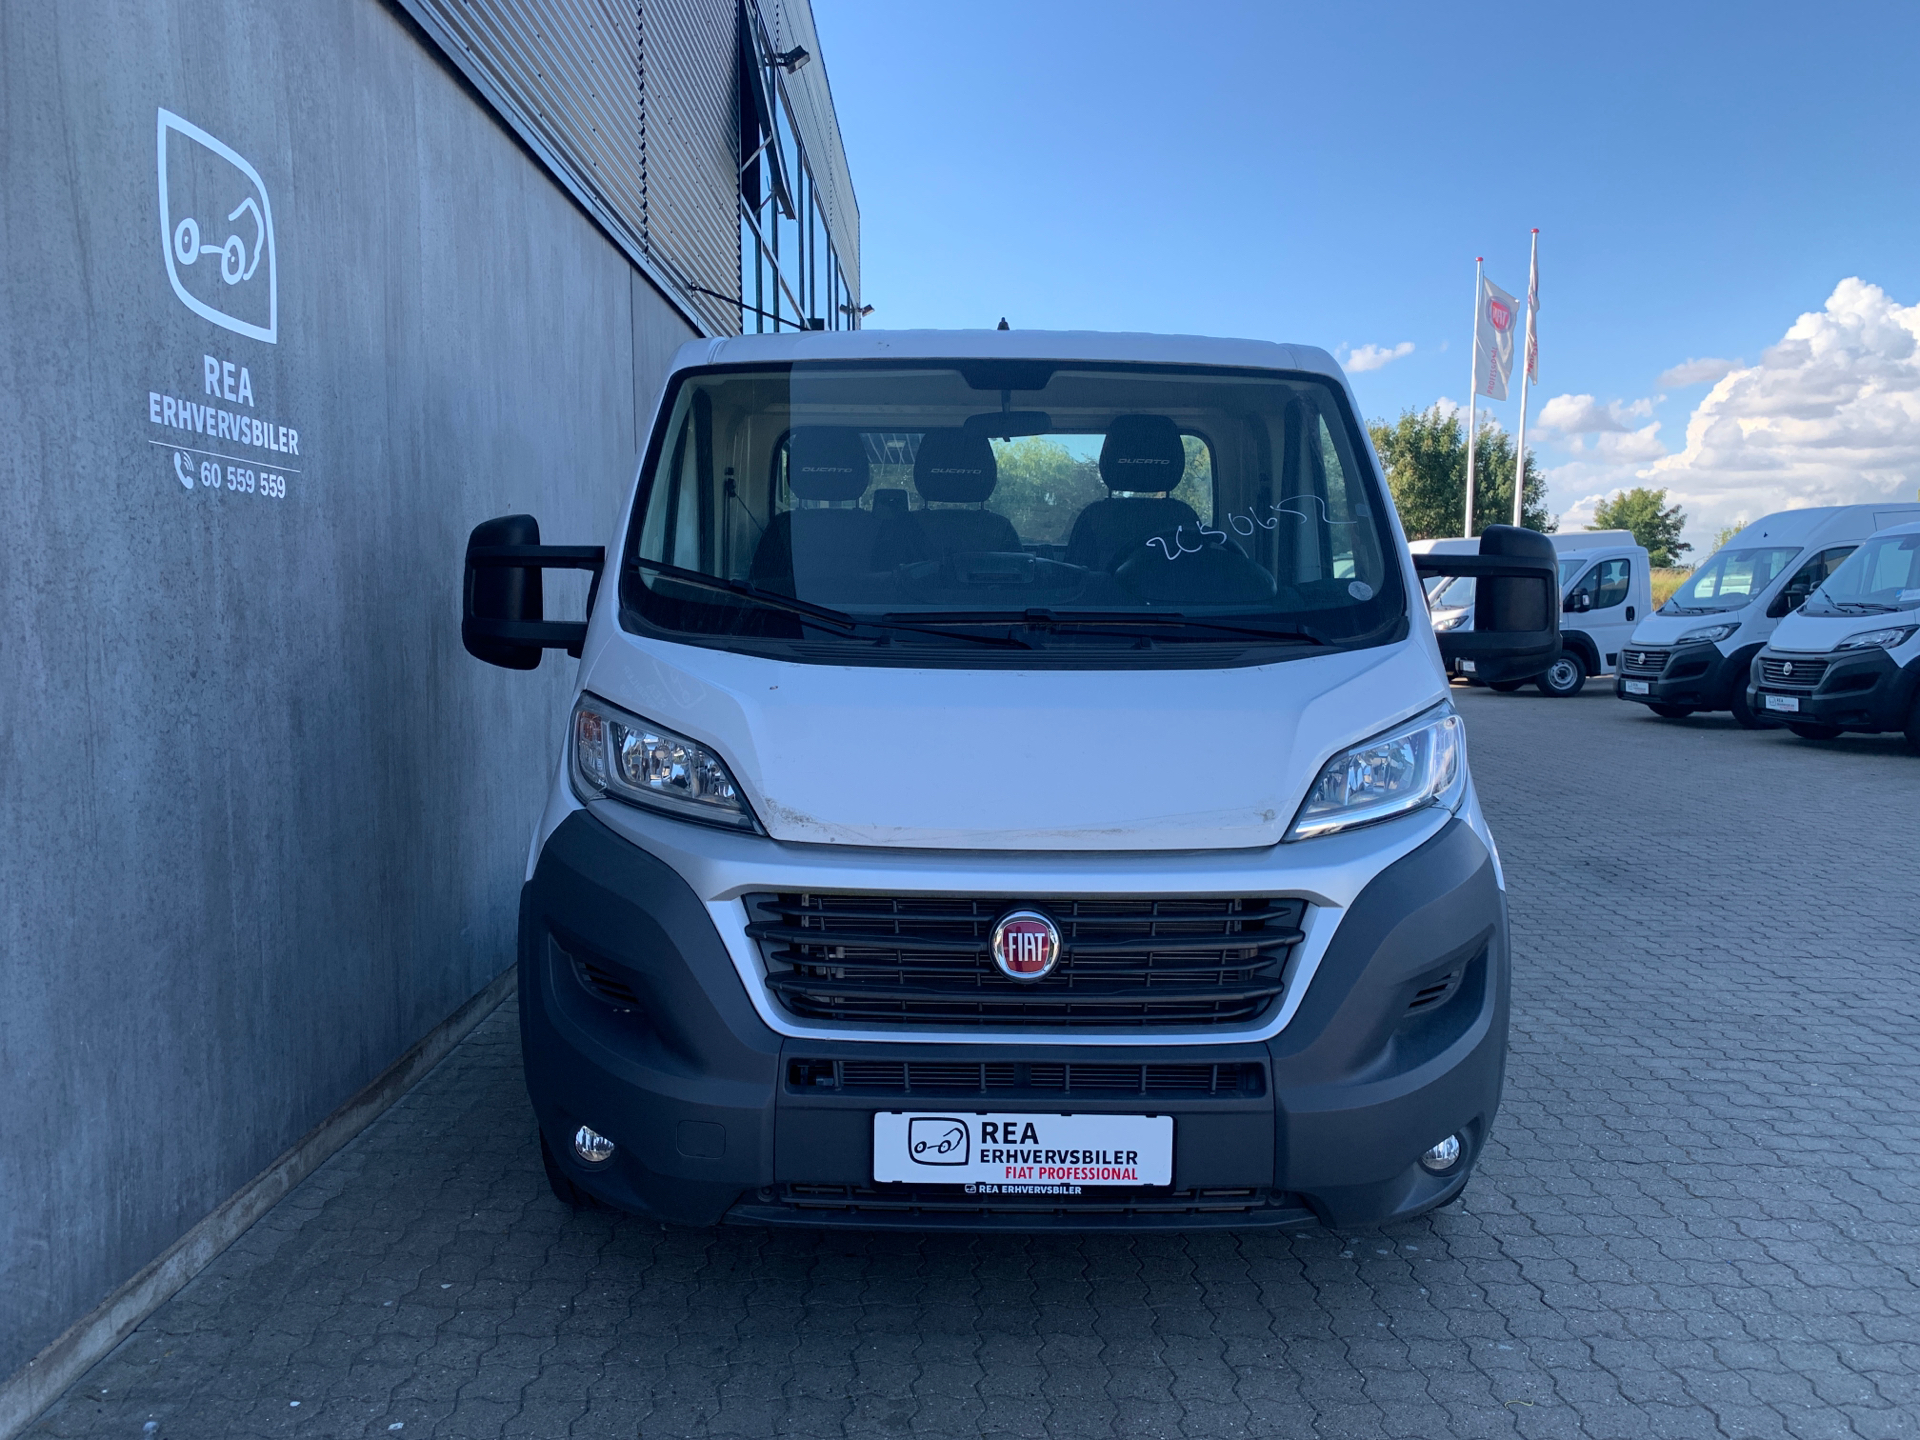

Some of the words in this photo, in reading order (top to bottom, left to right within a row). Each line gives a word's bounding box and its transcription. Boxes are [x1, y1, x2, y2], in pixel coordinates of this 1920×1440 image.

[204, 354, 254, 407] REA
[149, 391, 299, 455] ERHVERVSBILER
[201, 461, 221, 488] 60
[227, 466, 255, 494] 559
[260, 472, 286, 499] 559
[1008, 932, 1046, 962] FIAT
[981, 1121, 1039, 1145] REA
[980, 1149, 1138, 1165] ERHVERVSBILER
[1005, 1166, 1034, 1179] FIAT
[1039, 1167, 1138, 1180] PROFESSIONAL
[979, 1185, 999, 1194] REA
[1001, 1185, 1082, 1195] ERHVERVSBILER
